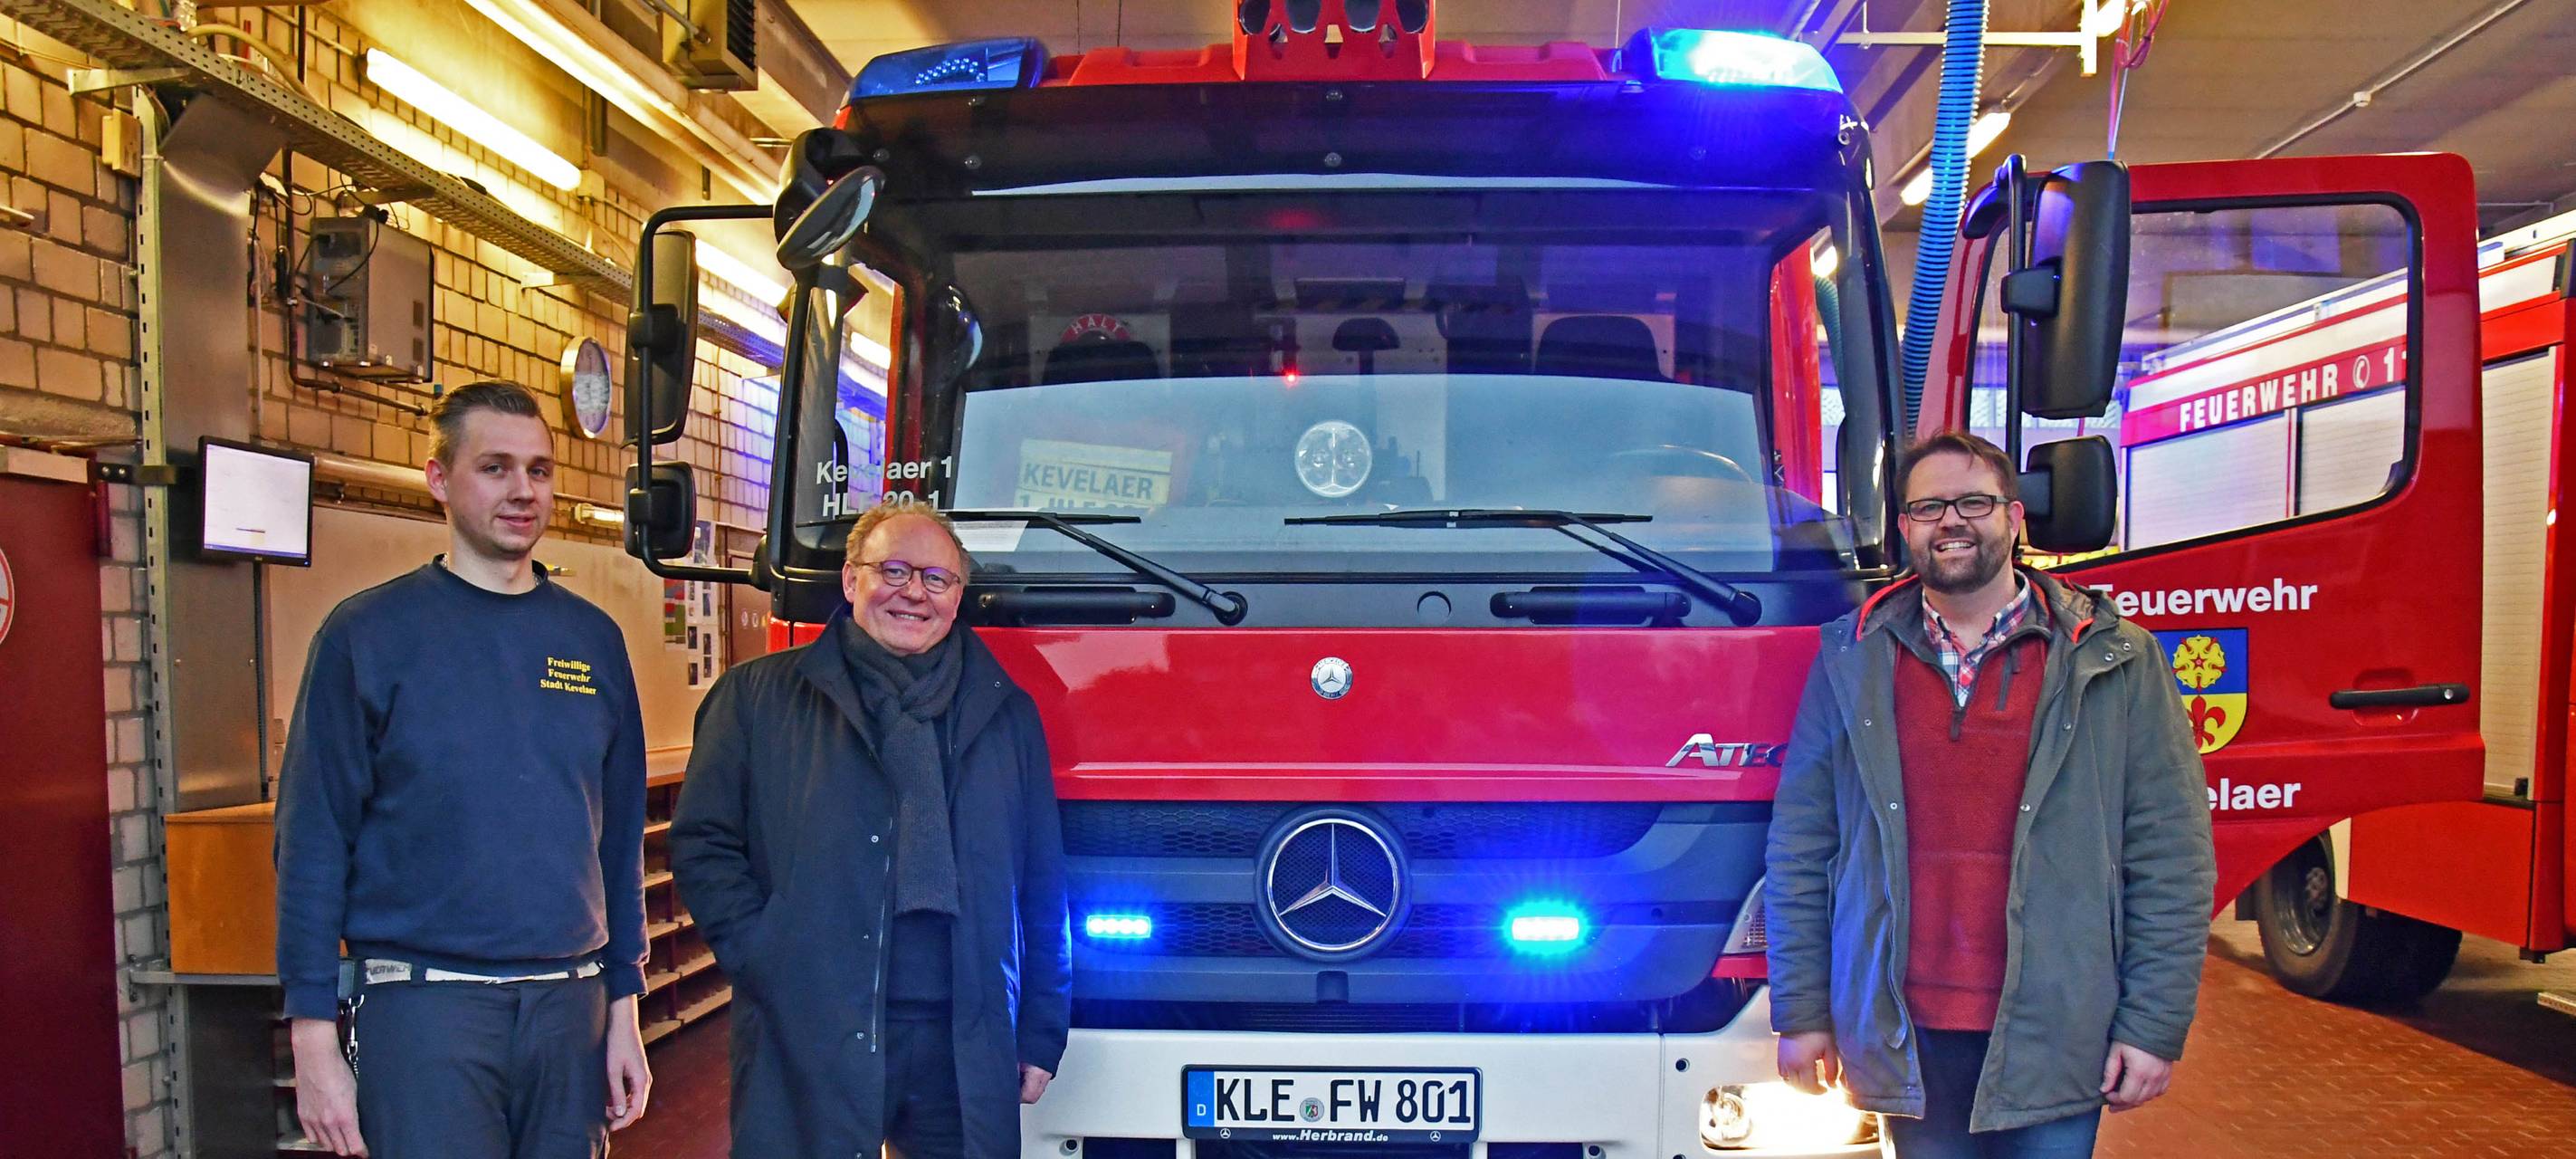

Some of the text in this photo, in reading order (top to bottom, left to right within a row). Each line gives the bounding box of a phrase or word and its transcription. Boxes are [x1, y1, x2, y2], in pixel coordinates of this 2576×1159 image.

[1071, 315, 1121, 334] HALT
[2180, 363, 2339, 433] FEUERWEHR
[816, 455, 952, 485] Kevelaer 1
[1023, 462, 1154, 501] KEVELAER
[2089, 578, 2318, 617] euerwehr
[547, 656, 591, 672] Freiwillige
[548, 668, 591, 683] Feuerwehr
[540, 679, 596, 694] Stadt Kevelaer
[1197, 1078, 1471, 1123] D KLE FW 801
[1272, 1129, 1388, 1143] www.Herbrand.de
